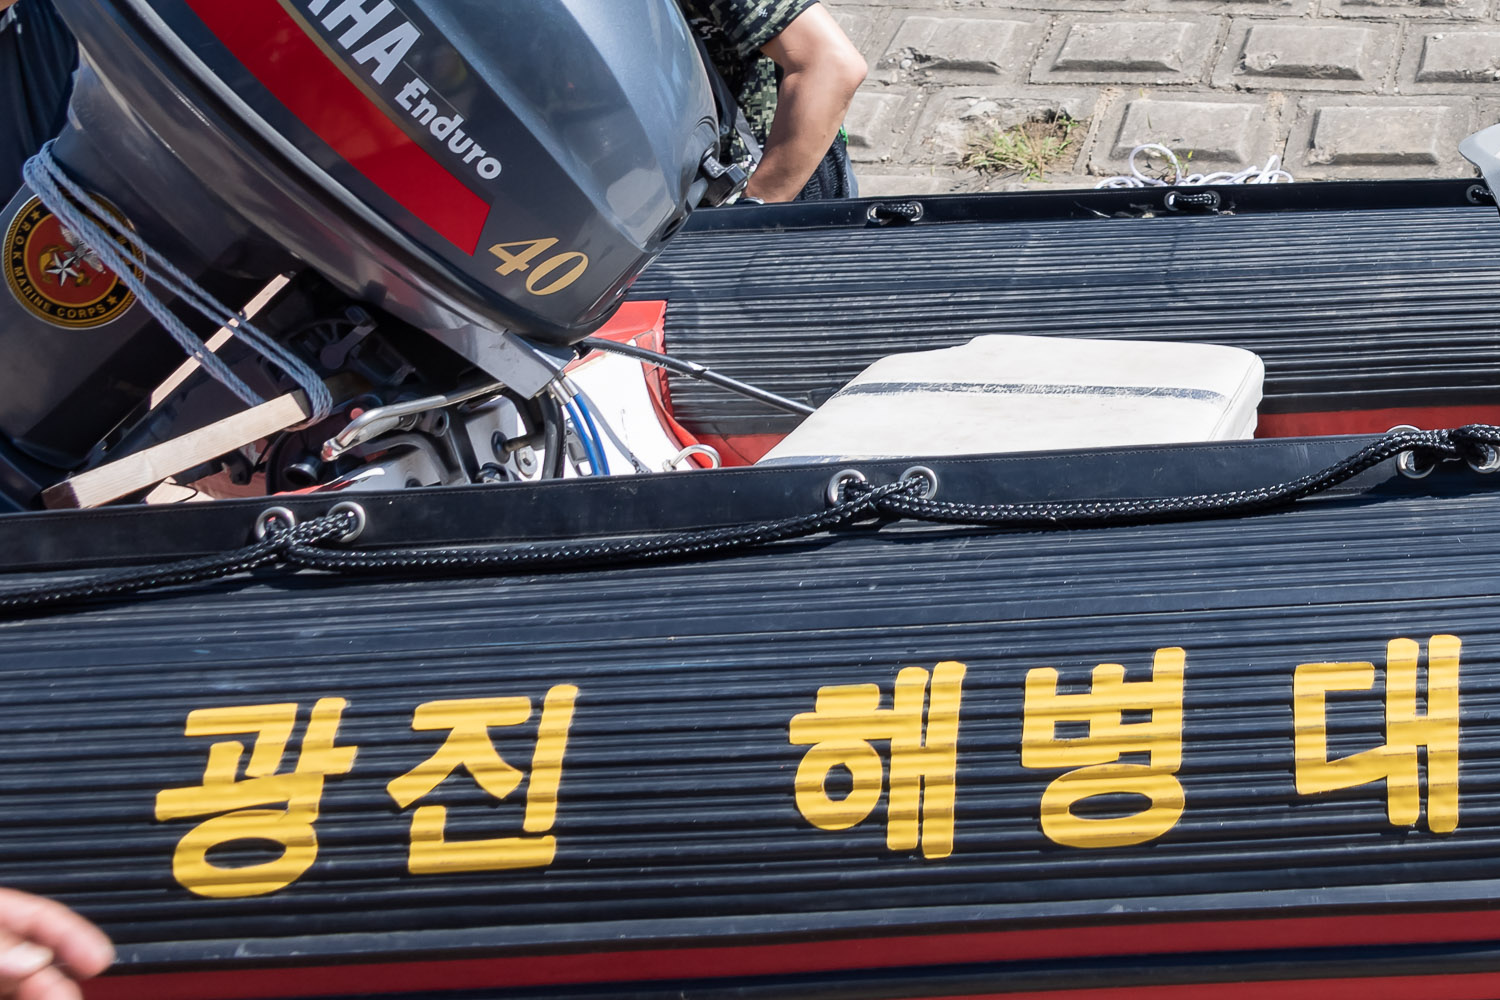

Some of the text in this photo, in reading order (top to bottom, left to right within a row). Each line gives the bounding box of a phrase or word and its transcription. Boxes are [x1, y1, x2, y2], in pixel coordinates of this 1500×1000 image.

[395, 78, 502, 181] Enduro
[13, 266, 53, 312] MARINE
[56, 303, 107, 319] CORPS
[488, 236, 589, 296] 40
[155, 684, 579, 898] 광진
[789, 634, 1462, 859] 해병대
